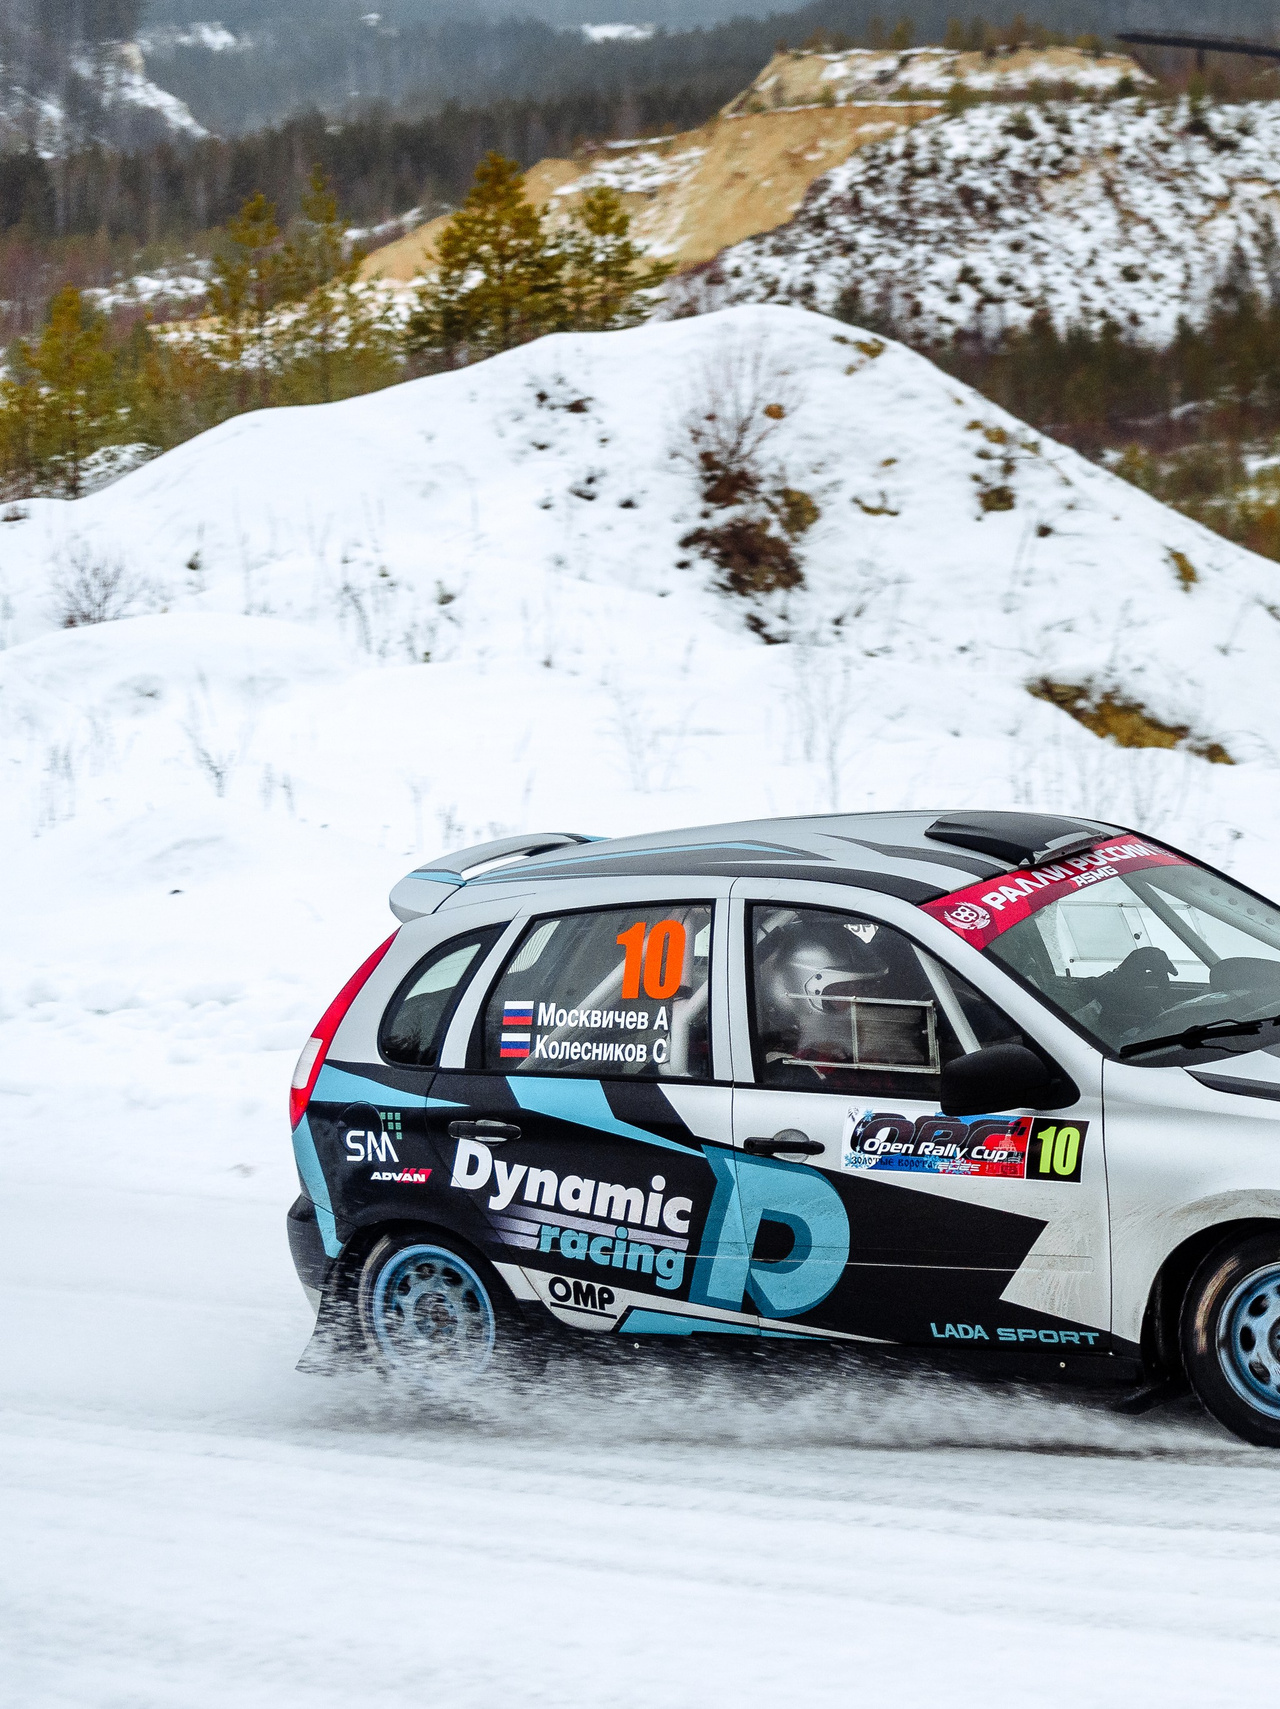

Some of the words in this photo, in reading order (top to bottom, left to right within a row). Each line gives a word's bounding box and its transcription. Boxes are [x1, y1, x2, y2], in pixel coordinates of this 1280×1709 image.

[981, 862, 1073, 912] РАЛЛИ
[1064, 843, 1157, 872] РОССИИ
[616, 919, 686, 1000] 10
[537, 1002, 649, 1029] Москвичев
[653, 1006, 669, 1030] А
[535, 1034, 647, 1062] Колесников
[652, 1038, 668, 1063] С
[346, 1130, 400, 1163] SM
[864, 1137, 914, 1155] Open
[917, 1141, 968, 1160] Rally
[971, 1146, 1009, 1162] Cup
[1037, 1126, 1081, 1176] 10
[371, 1171, 426, 1183] ADVAN
[451, 1138, 693, 1233] Dynamic
[538, 1224, 686, 1290] racing
[549, 1276, 615, 1308] OMP
[930, 1322, 990, 1341] LADA
[997, 1327, 1100, 1345] SPORT
